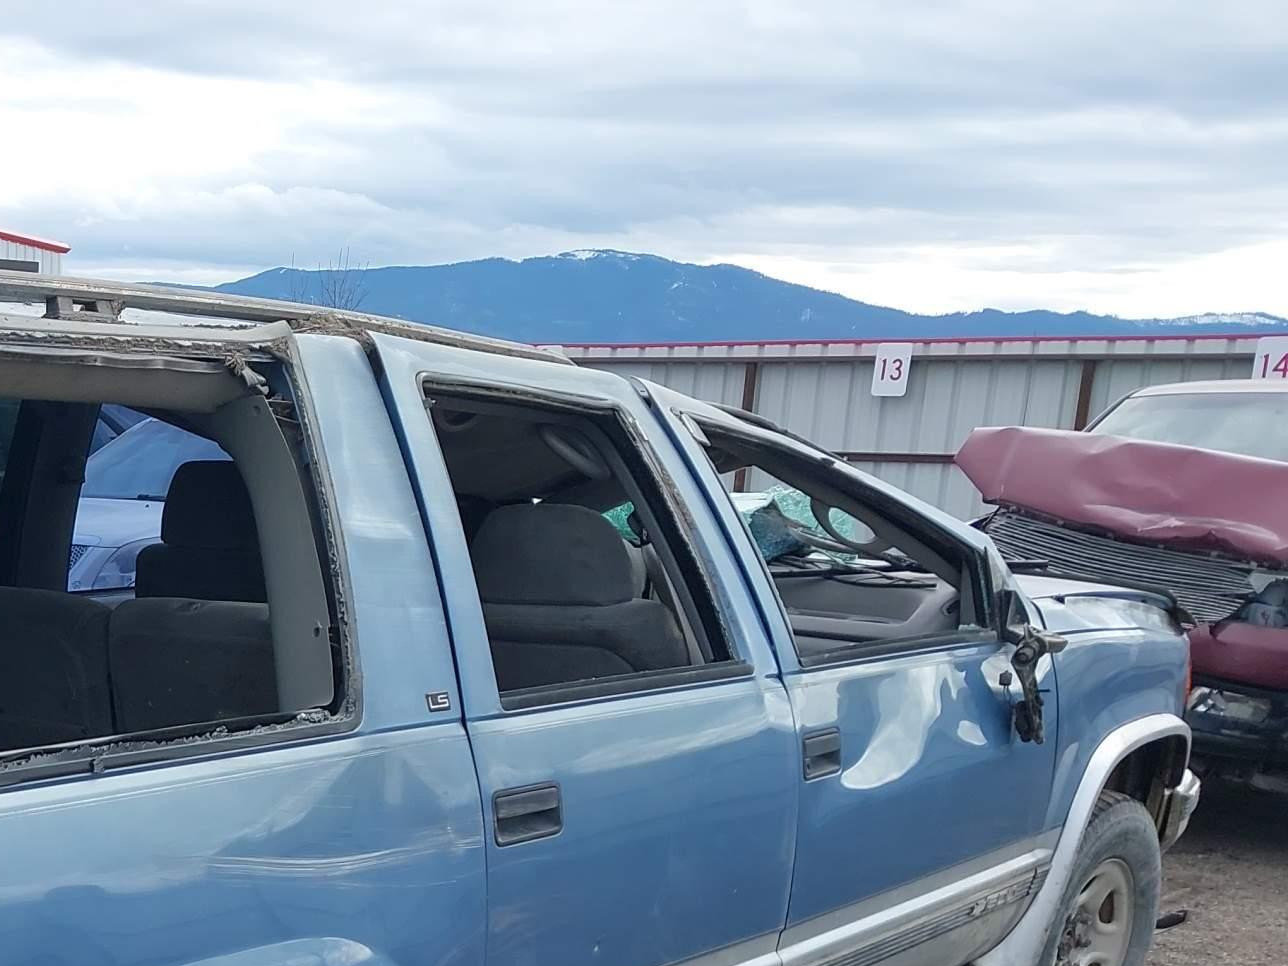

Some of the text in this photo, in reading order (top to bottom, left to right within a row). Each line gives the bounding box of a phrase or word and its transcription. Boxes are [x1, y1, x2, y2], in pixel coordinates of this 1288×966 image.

[880, 358, 903, 381] 13
[1261, 353, 1288, 378] 14
[427, 693, 450, 709] LS
